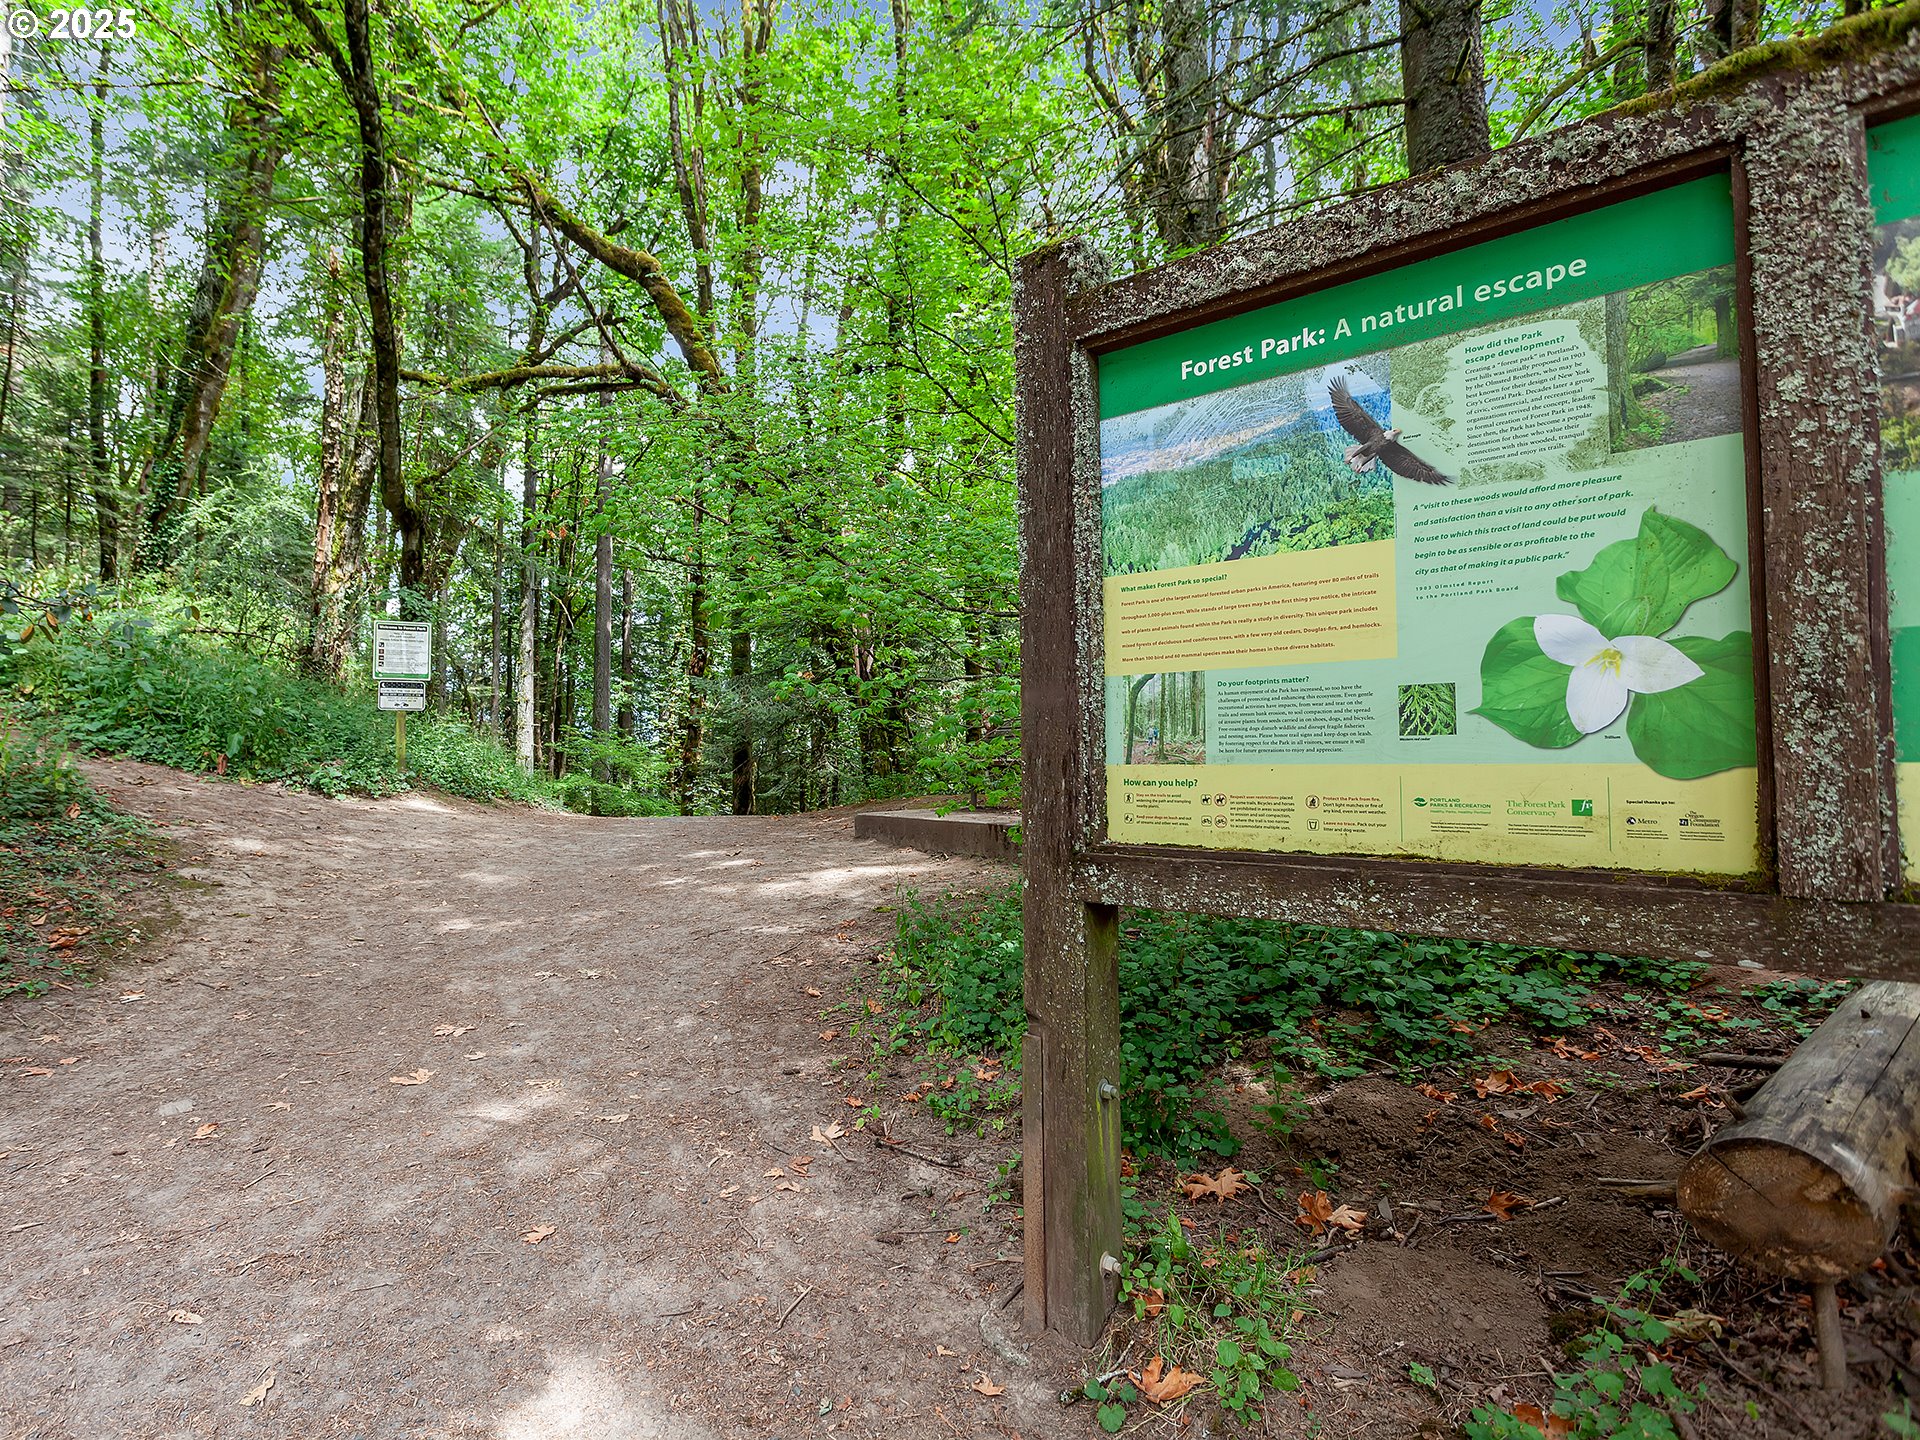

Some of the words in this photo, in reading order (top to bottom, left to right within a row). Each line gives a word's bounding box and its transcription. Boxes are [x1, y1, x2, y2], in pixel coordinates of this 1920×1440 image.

[1182, 344, 1252, 380] Forest
[1262, 324, 1324, 359] Park:
[1335, 317, 1350, 340] A
[1362, 288, 1462, 333] natural
[1475, 261, 1586, 304] escape
[1465, 344, 1484, 354] How
[1487, 339, 1501, 349] did
[1504, 336, 1518, 345] the
[1522, 329, 1542, 341] Park
[1465, 352, 1495, 364] escape
[1498, 335, 1564, 357] development?
[1465, 365, 1491, 374] Creating
[1497, 358, 1518, 367] “forest
[1520, 353, 1537, 364] park”
[1547, 345, 1579, 356] Portland’s
[1465, 374, 1478, 382] west
[1506, 363, 1530, 373] initially
[1532, 356, 1561, 370] proposed
[1571, 350, 1585, 359] 1903
[1485, 375, 1511, 386] Olmsted
[1513, 371, 1541, 380] Brothers,
[1420, 501, 1440, 510] “visit
[1473, 492, 1500, 502] woods
[1501, 488, 1528, 498] would
[1529, 483, 1556, 494] afford
[1557, 482, 1580, 490] more
[1582, 476, 1622, 488] pleasure
[1414, 518, 1429, 527] and
[1430, 513, 1476, 525] satisfaction
[1477, 510, 1496, 518] than
[1505, 505, 1522, 514] visit
[1552, 499, 1576, 507] other
[1578, 495, 1596, 504] sort
[1598, 493, 1608, 501] of
[1608, 490, 1633, 501] park.
[1450, 529, 1473, 539] which
[1474, 527, 1489, 535] this
[1490, 525, 1510, 533] tract
[1522, 520, 1541, 529] land
[1542, 517, 1567, 526] could
[1580, 514, 1596, 524] put
[1597, 509, 1626, 519] would
[1414, 550, 1436, 560] begin
[1469, 542, 1502, 552] sensible
[1524, 534, 1567, 548] profitable
[1415, 568, 1429, 576] city
[1440, 564, 1457, 572] that
[1468, 560, 1499, 569] making
[1514, 555, 1541, 566] public
[1542, 551, 1569, 563] park.”
[1202, 574, 1227, 584] special?
[1245, 678, 1280, 686] footprints
[1175, 779, 1197, 788] help?
[1506, 808, 1556, 818] Conservancy
